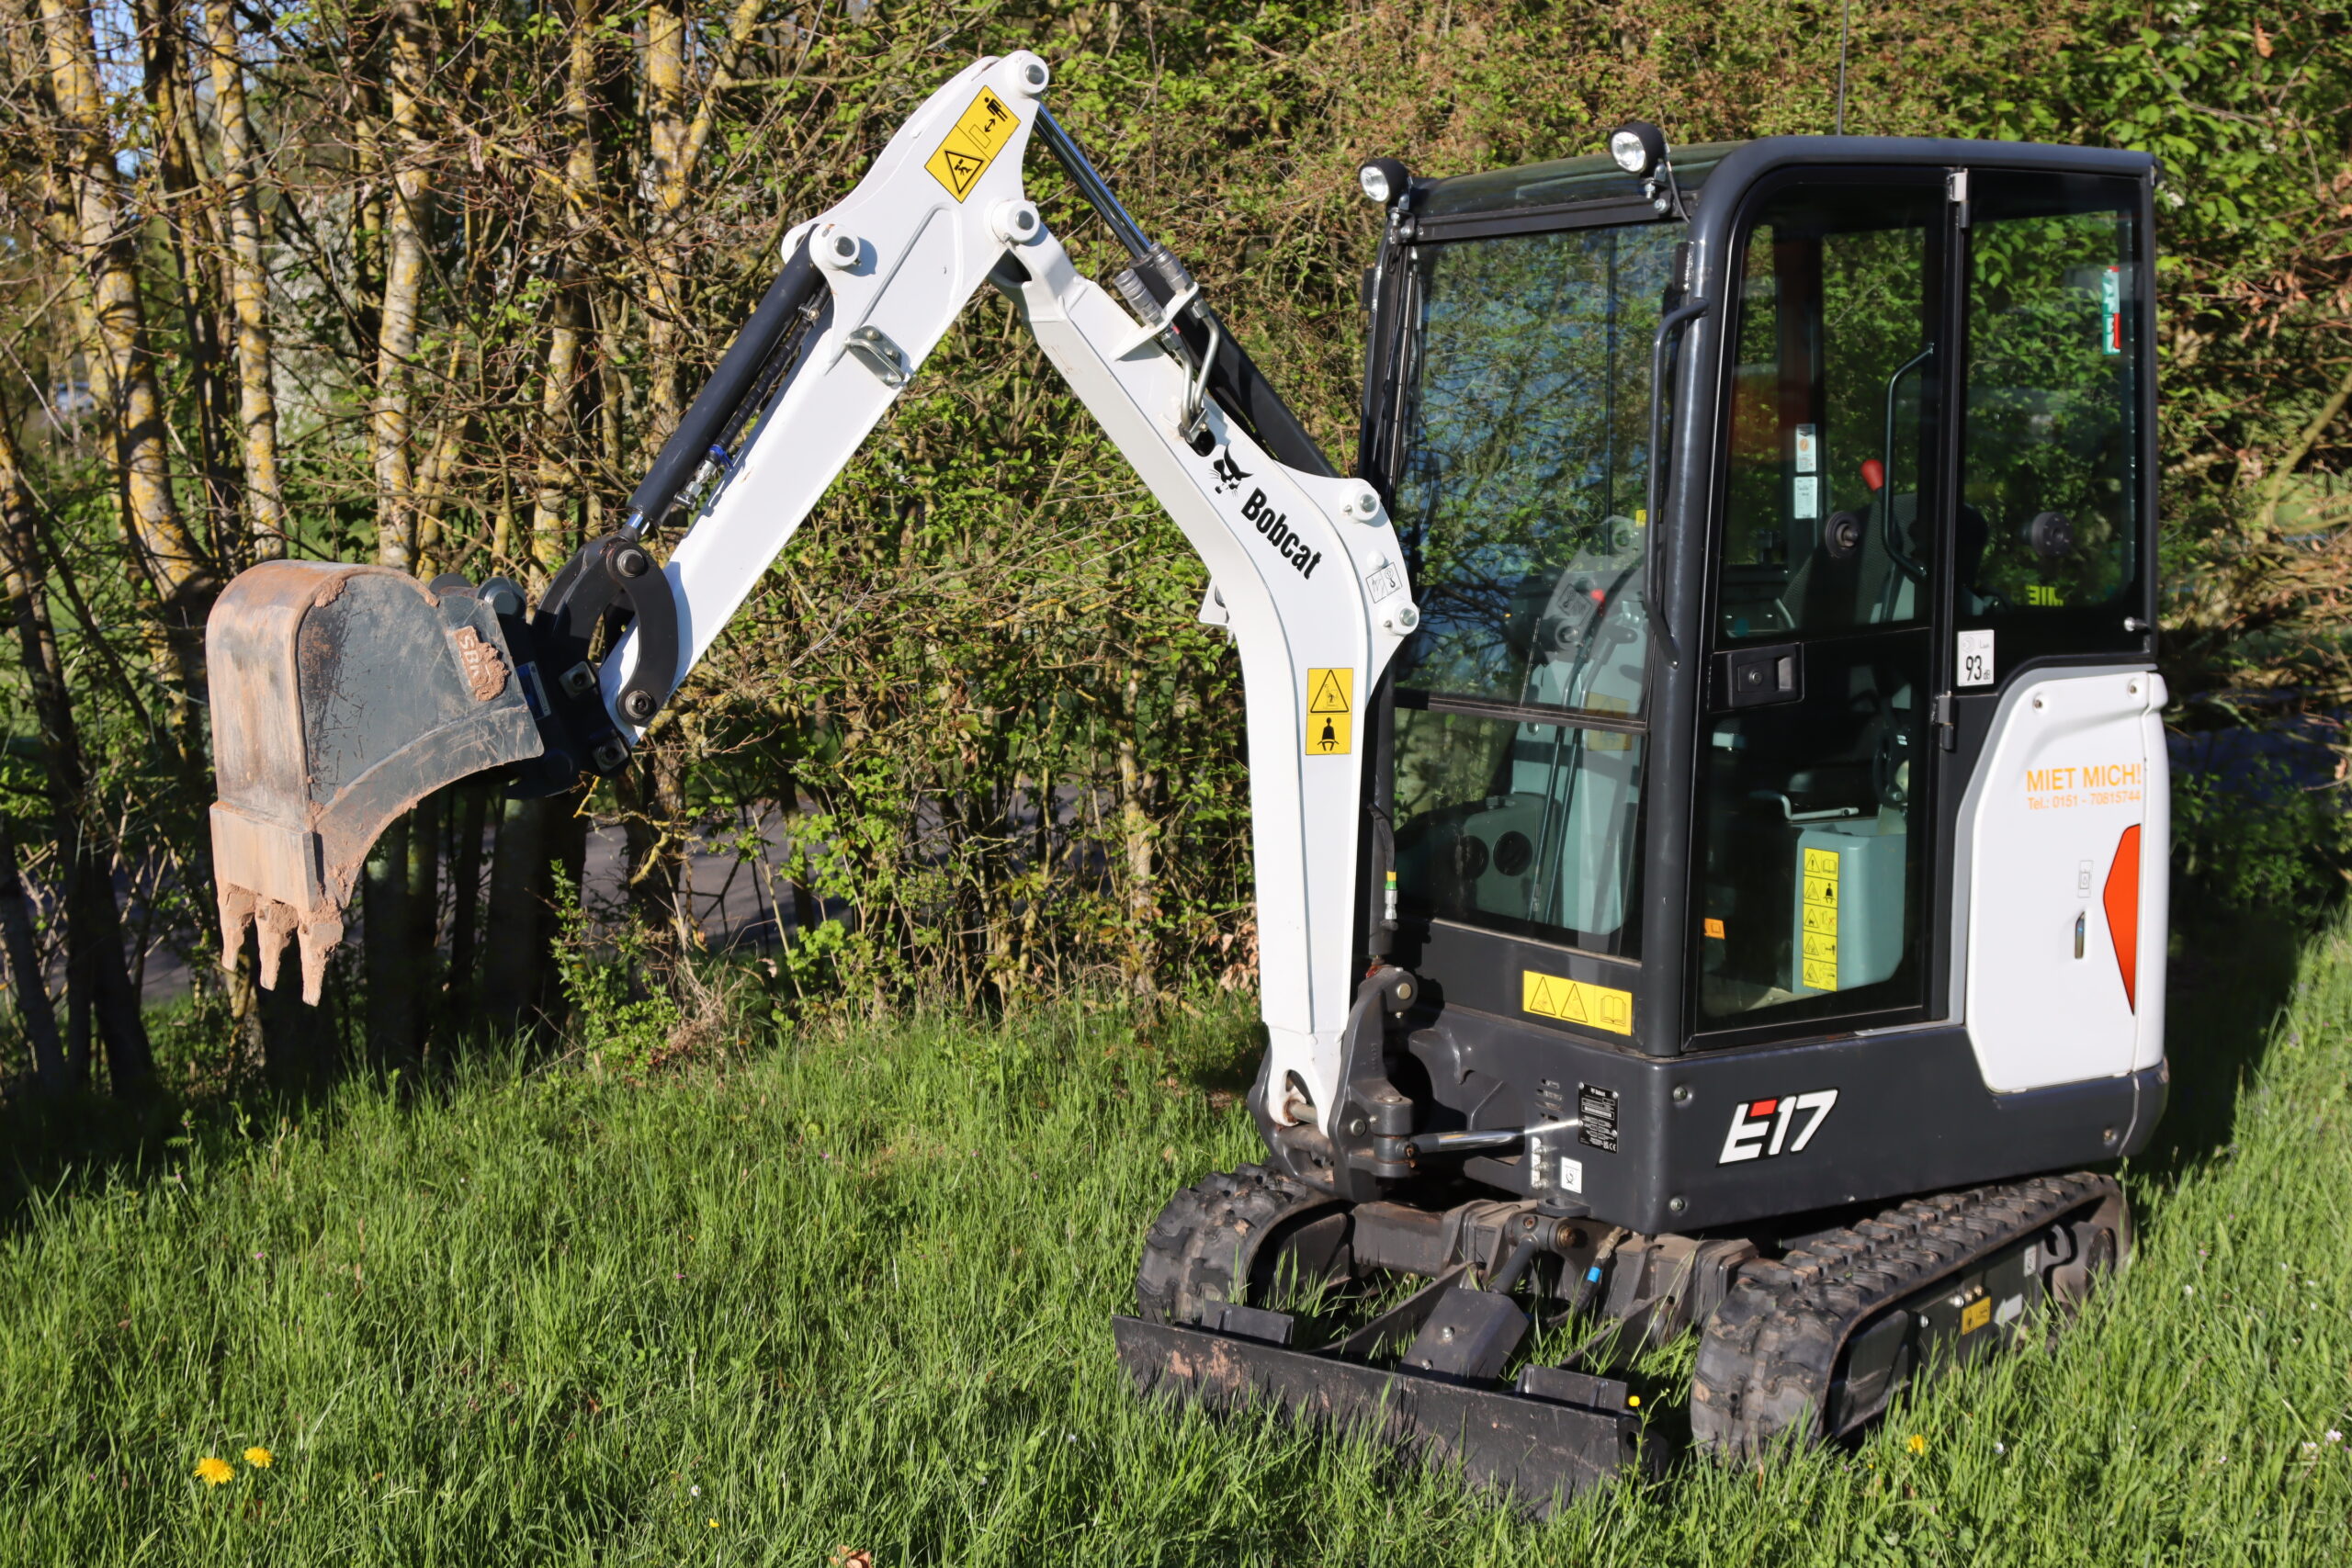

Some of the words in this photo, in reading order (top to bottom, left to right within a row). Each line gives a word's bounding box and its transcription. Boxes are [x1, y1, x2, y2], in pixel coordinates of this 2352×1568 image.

[1241, 487, 1322, 580] Bobcat
[1966, 654, 1983, 682] 93
[2026, 768, 2076, 792] MIET
[2083, 763, 2142, 788] MICH!
[2028, 796, 2049, 810] Tel.:
[2052, 794, 2078, 808] 0151
[1718, 1089, 1839, 1166] E17
